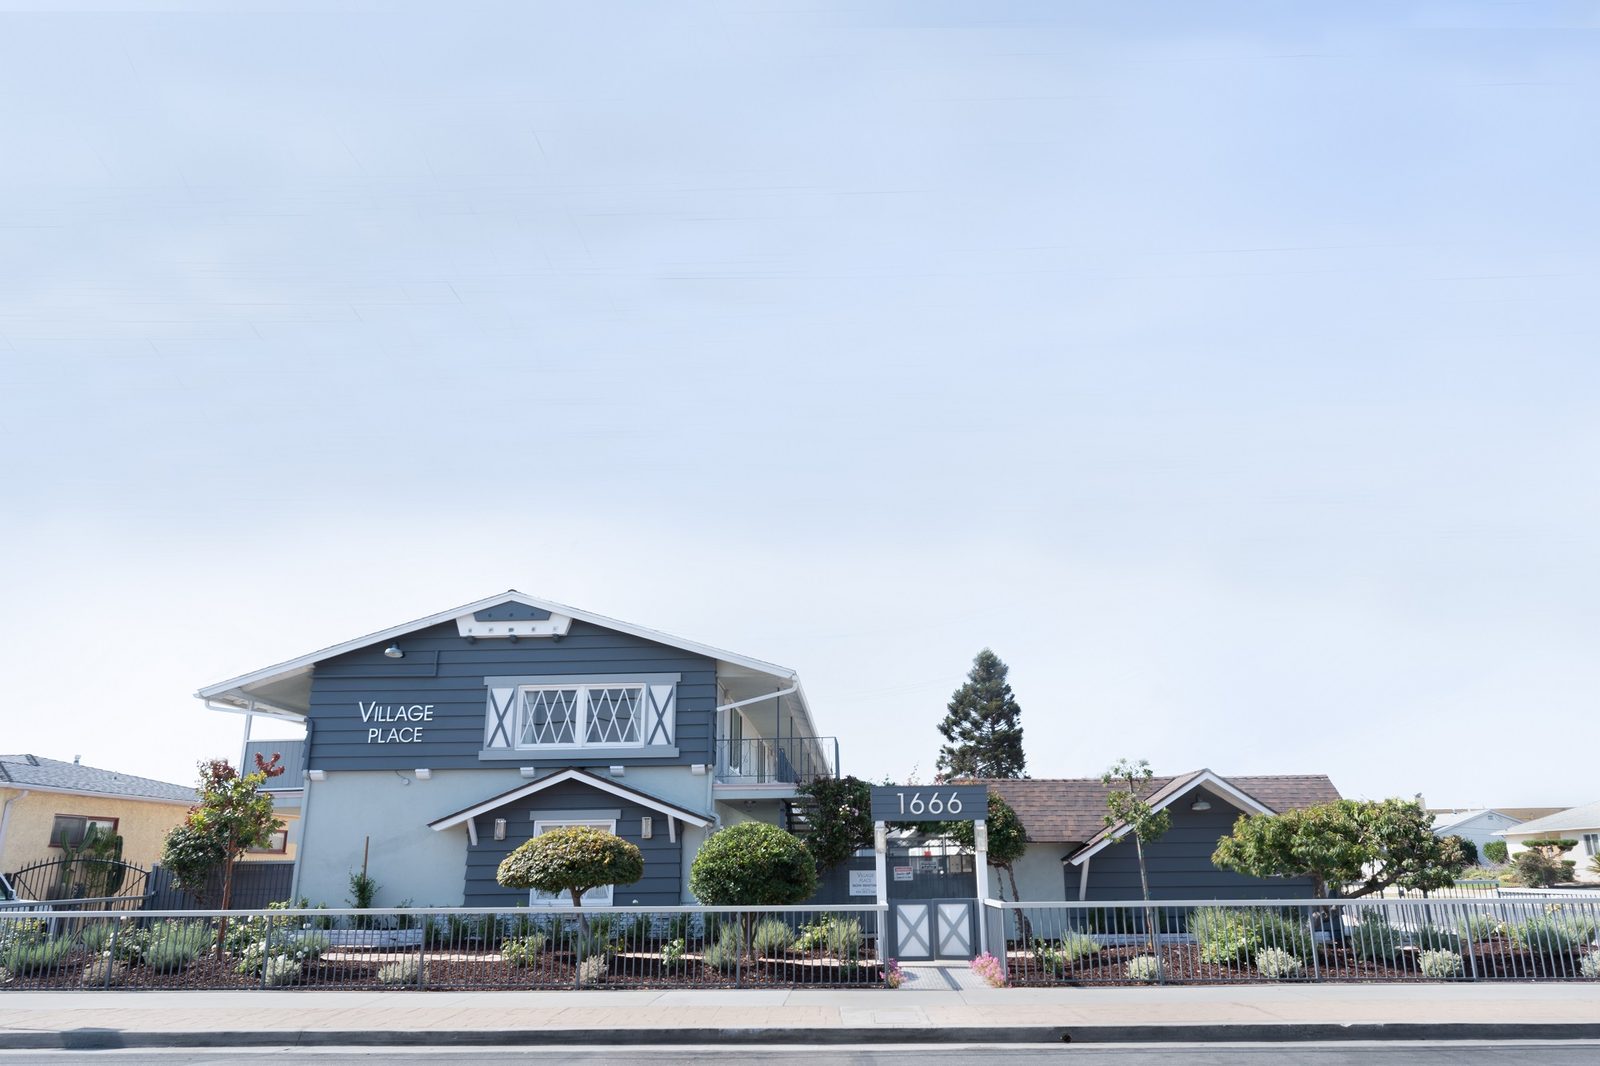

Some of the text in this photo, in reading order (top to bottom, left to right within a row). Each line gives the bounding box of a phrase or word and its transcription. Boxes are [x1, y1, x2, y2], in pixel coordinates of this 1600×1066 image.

[359, 701, 434, 722] VILLAGE
[367, 727, 423, 743] PLACE
[897, 792, 962, 814] 1666
